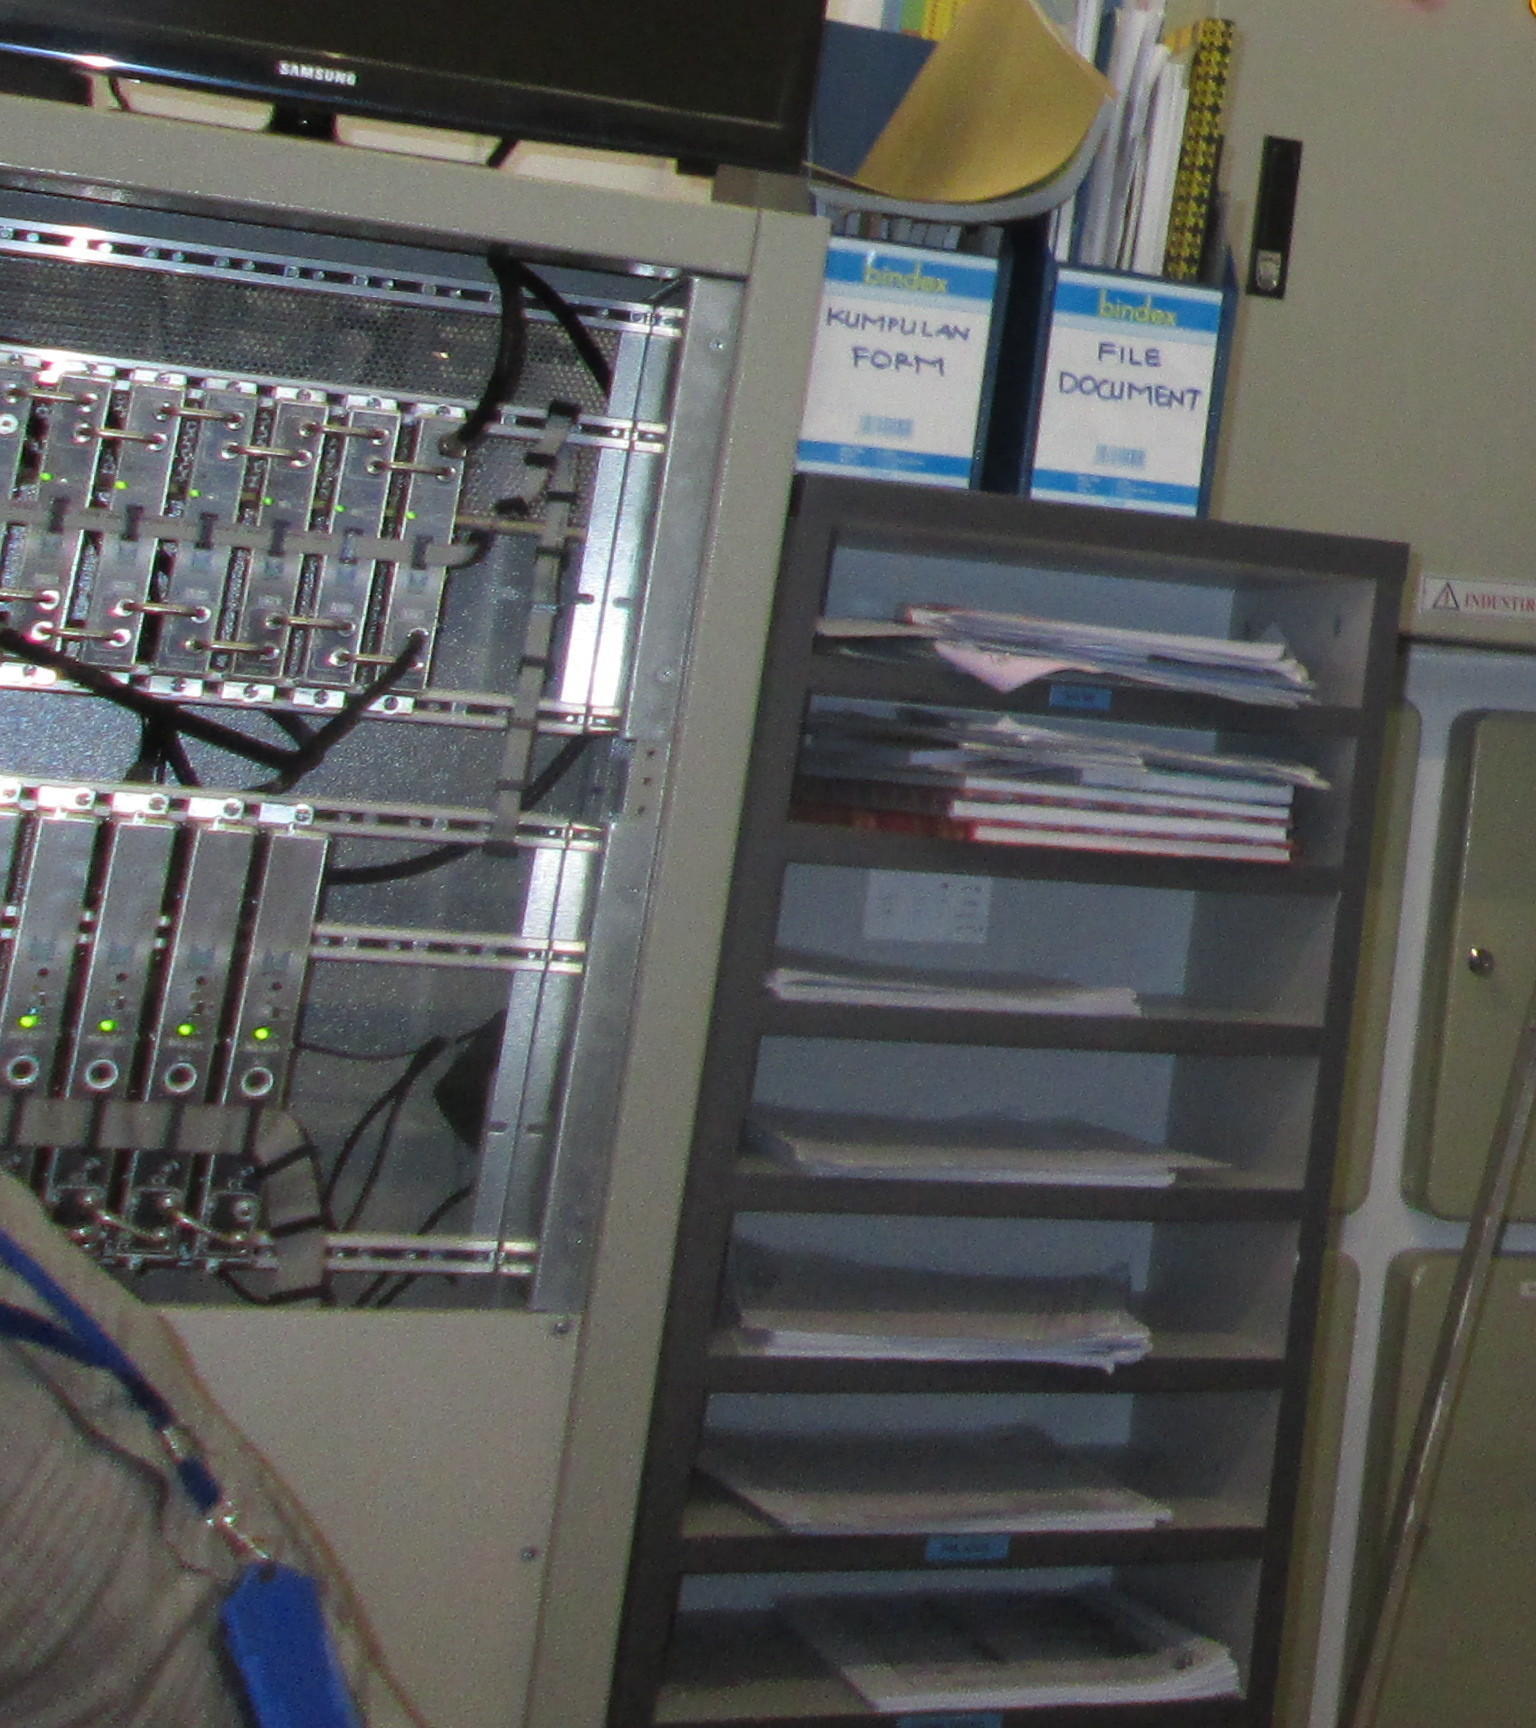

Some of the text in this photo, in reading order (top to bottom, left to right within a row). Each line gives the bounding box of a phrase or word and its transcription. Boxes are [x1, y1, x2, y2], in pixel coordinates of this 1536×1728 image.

[277, 60, 357, 87] SAMSUNG
[1097, 287, 1178, 327] bindex
[825, 306, 971, 343] KUMPULAN
[851, 345, 945, 377] FORM
[1097, 341, 1163, 369] FILE
[1058, 370, 1201, 412] DOCUMENT
